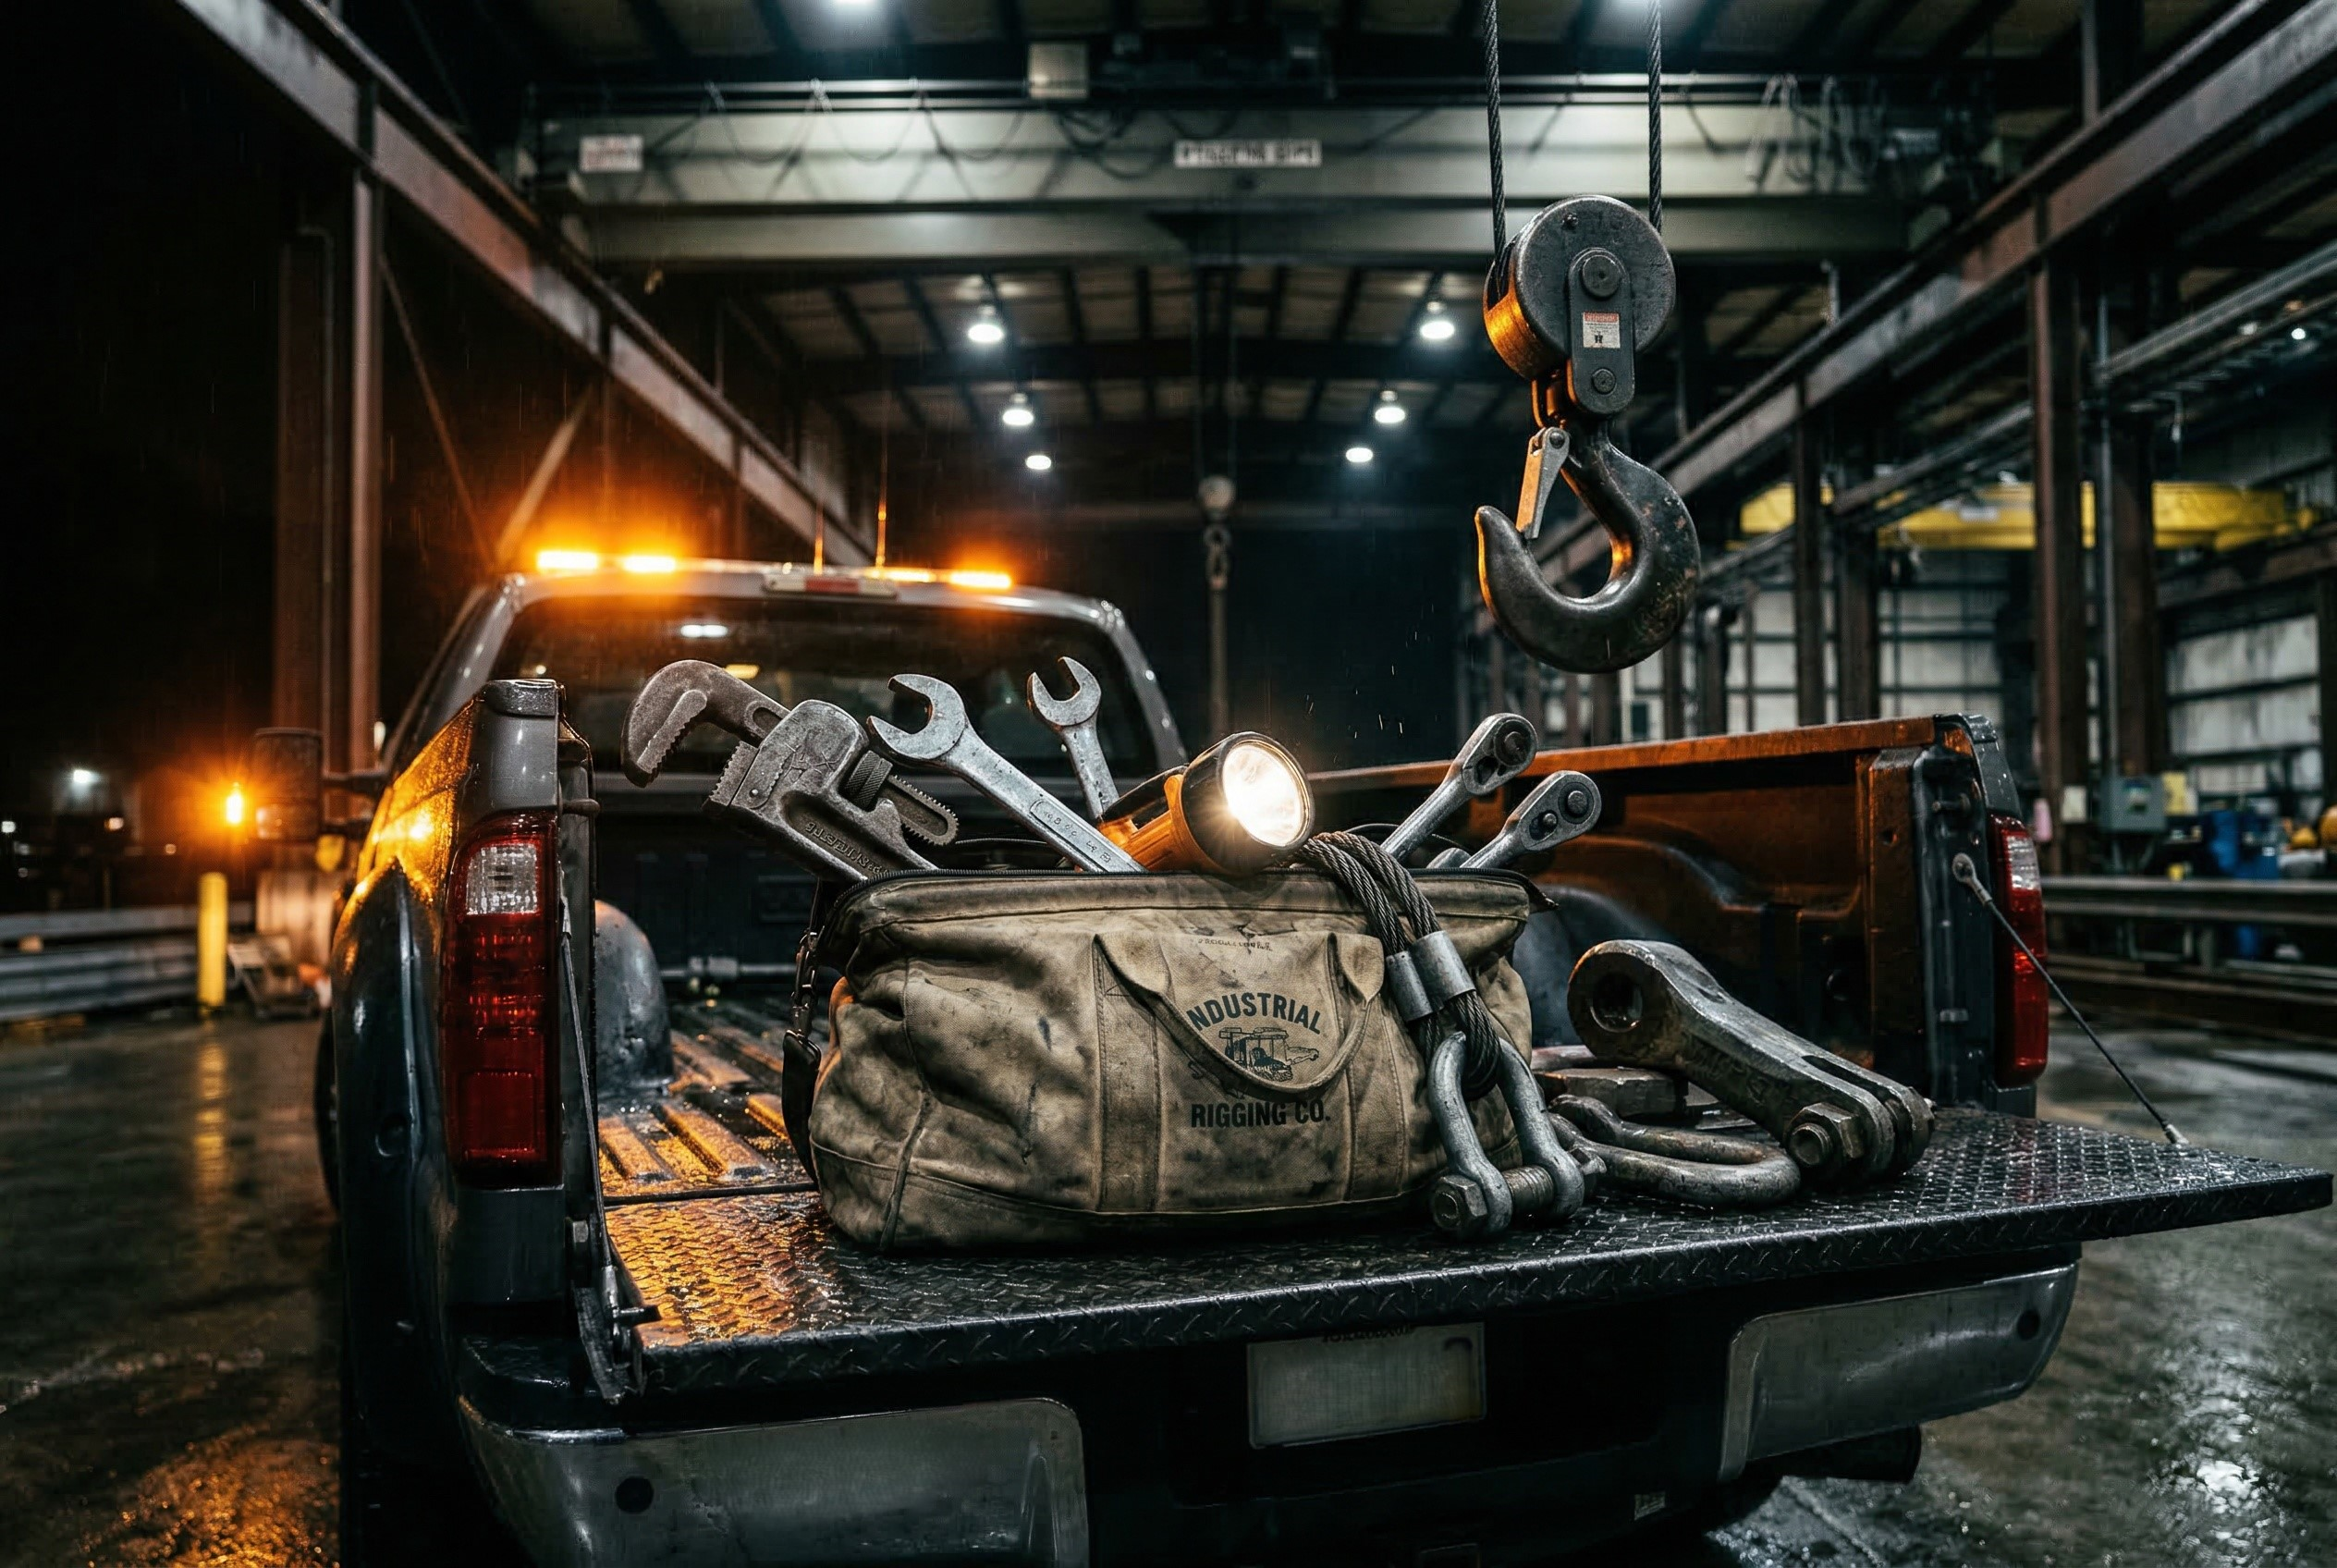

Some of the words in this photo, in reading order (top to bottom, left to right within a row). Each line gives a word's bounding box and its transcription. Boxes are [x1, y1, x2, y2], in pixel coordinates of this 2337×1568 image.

[1186, 992, 1321, 1035] NDUSTRIAL
[1191, 1101, 1287, 1128] RIGGING
[1294, 1098, 1331, 1124] CO.
